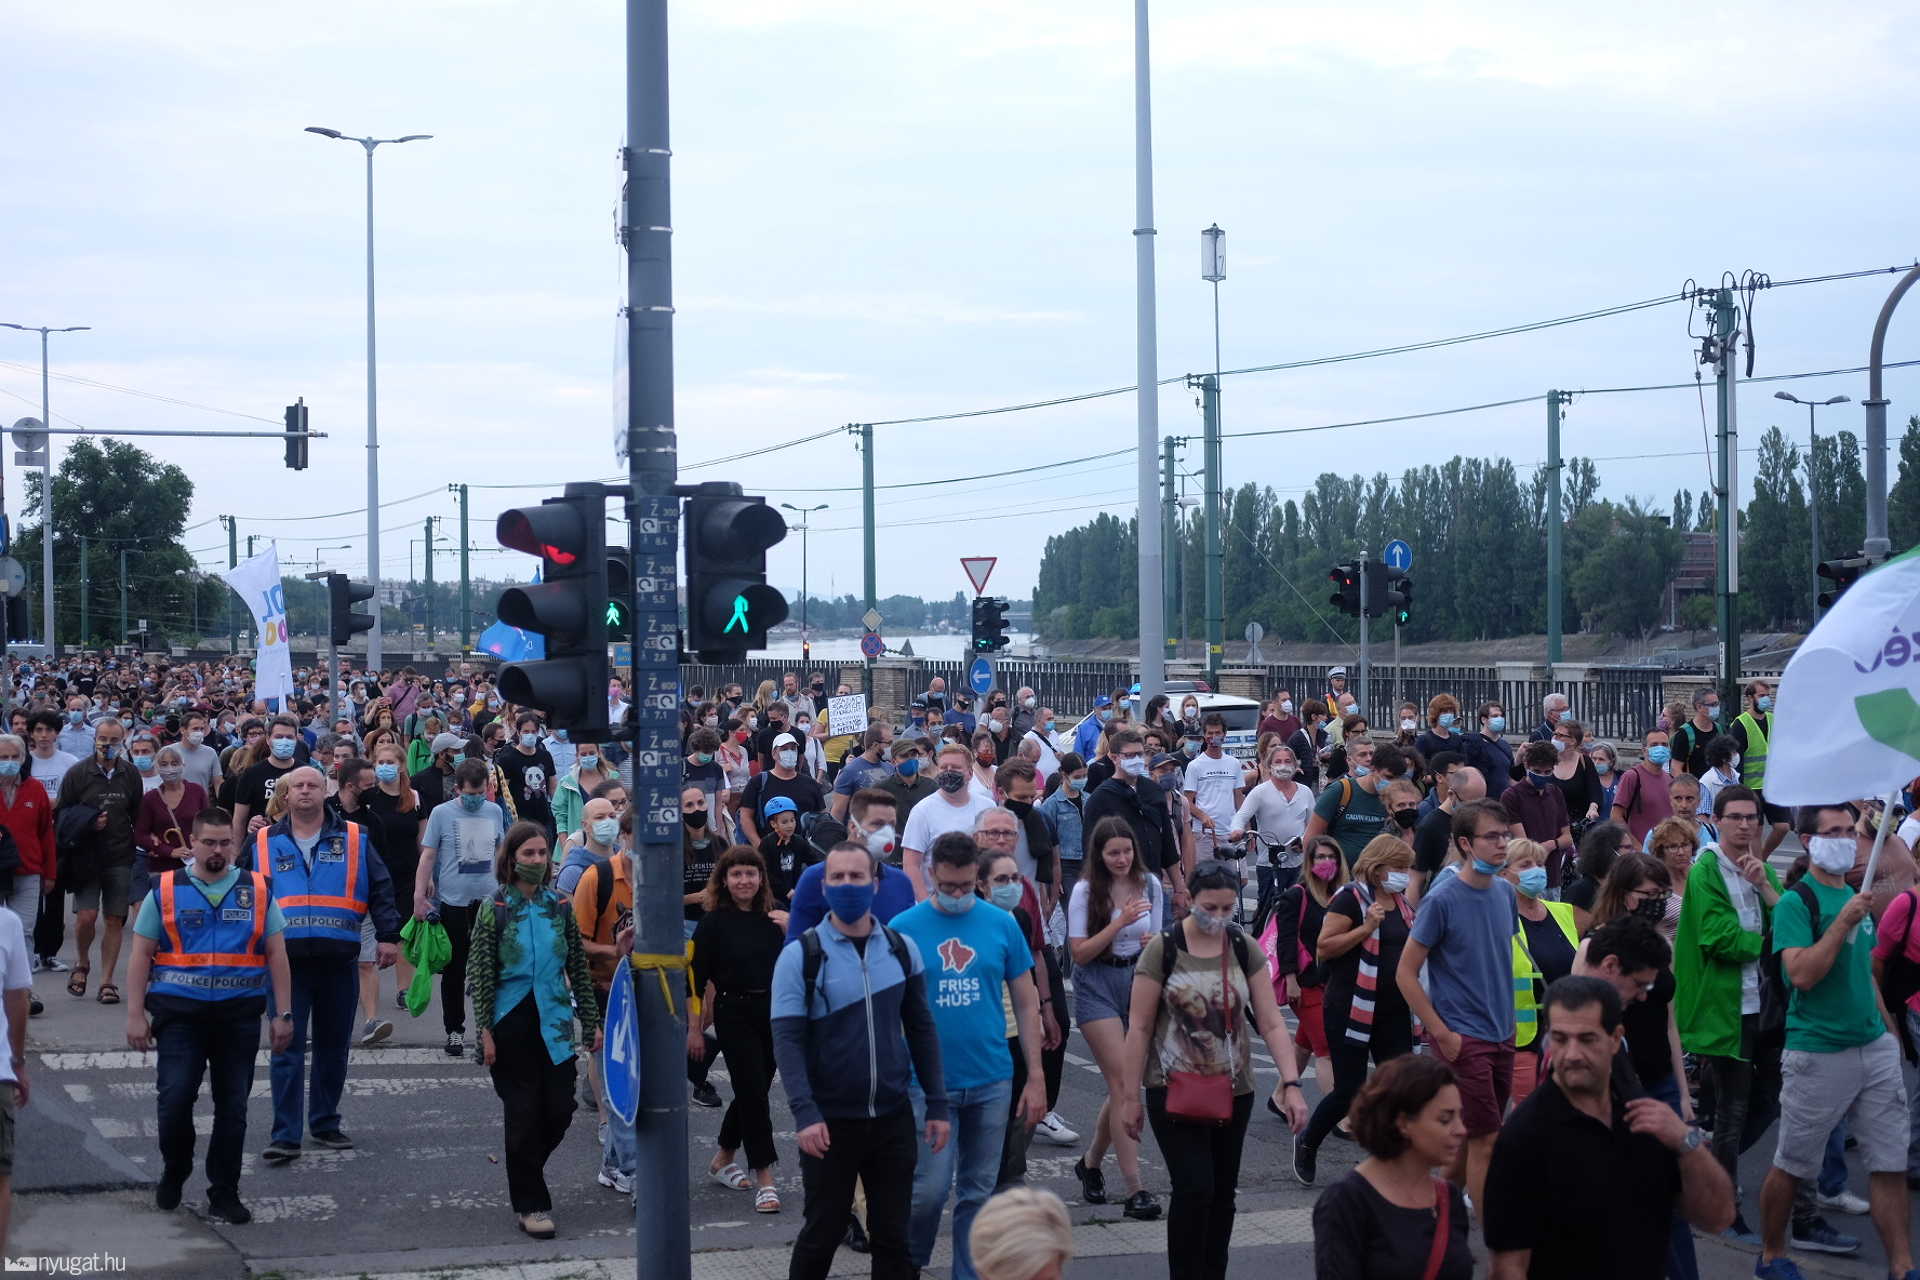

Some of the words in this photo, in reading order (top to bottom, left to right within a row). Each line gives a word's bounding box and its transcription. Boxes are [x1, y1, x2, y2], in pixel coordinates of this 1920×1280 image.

[650, 503, 658, 517] Z
[647, 561, 655, 575] Z
[648, 619, 656, 632] Z
[648, 677, 657, 690] Z
[650, 735, 658, 749] Z
[650, 793, 659, 806] Z
[311, 917, 346, 928] POLICE
[171, 973, 209, 988] POLICE
[214, 976, 253, 987] POLICE
[938, 977, 980, 992] FRISS
